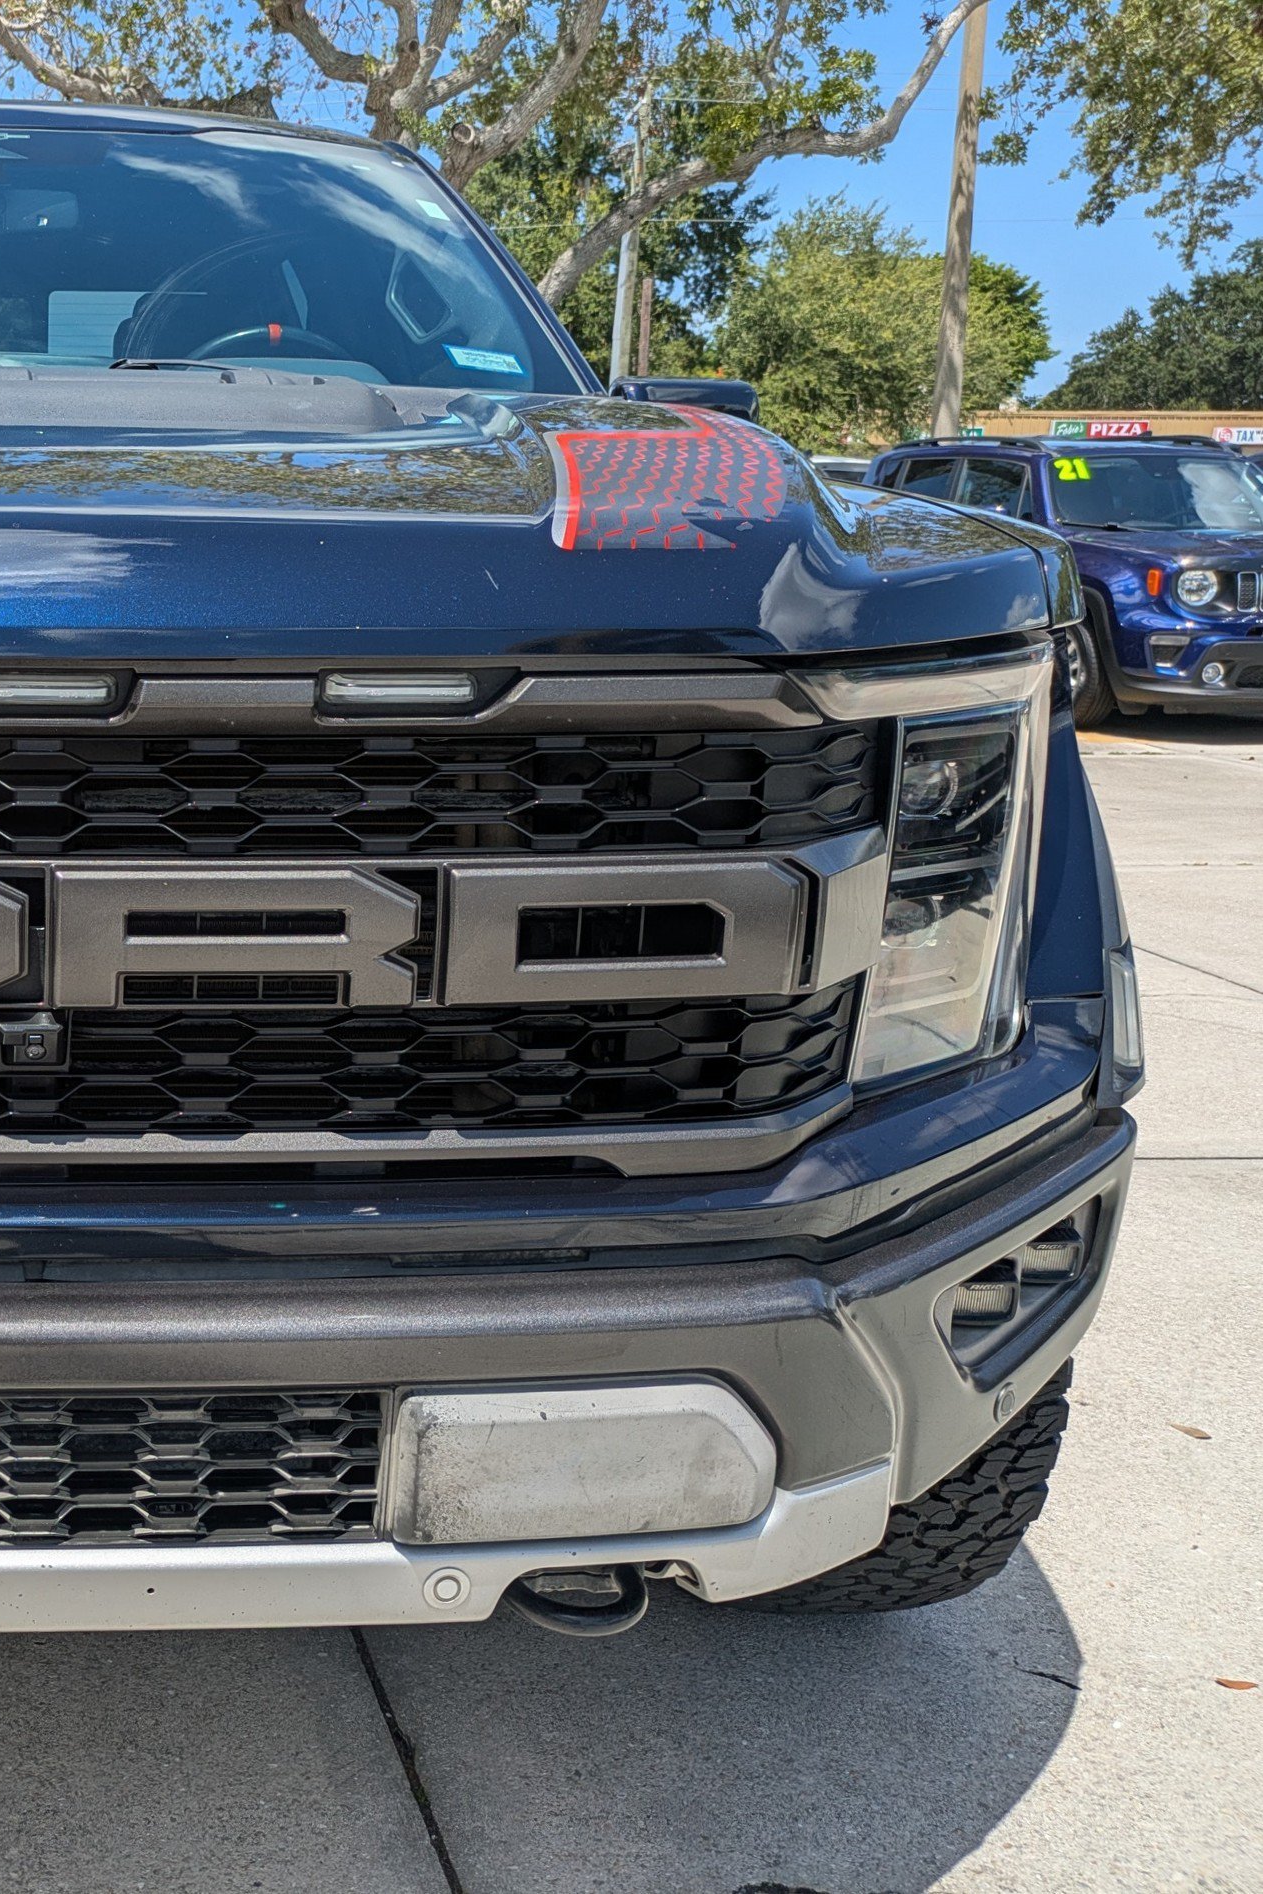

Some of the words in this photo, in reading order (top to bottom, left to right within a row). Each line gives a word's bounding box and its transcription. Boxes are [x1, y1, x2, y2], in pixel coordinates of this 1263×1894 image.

[1056, 422, 1084, 436] Fabio's
[1090, 423, 1142, 436] PIZZA
[1236, 430, 1255, 442] TAX
[1054, 457, 1091, 481] 21
